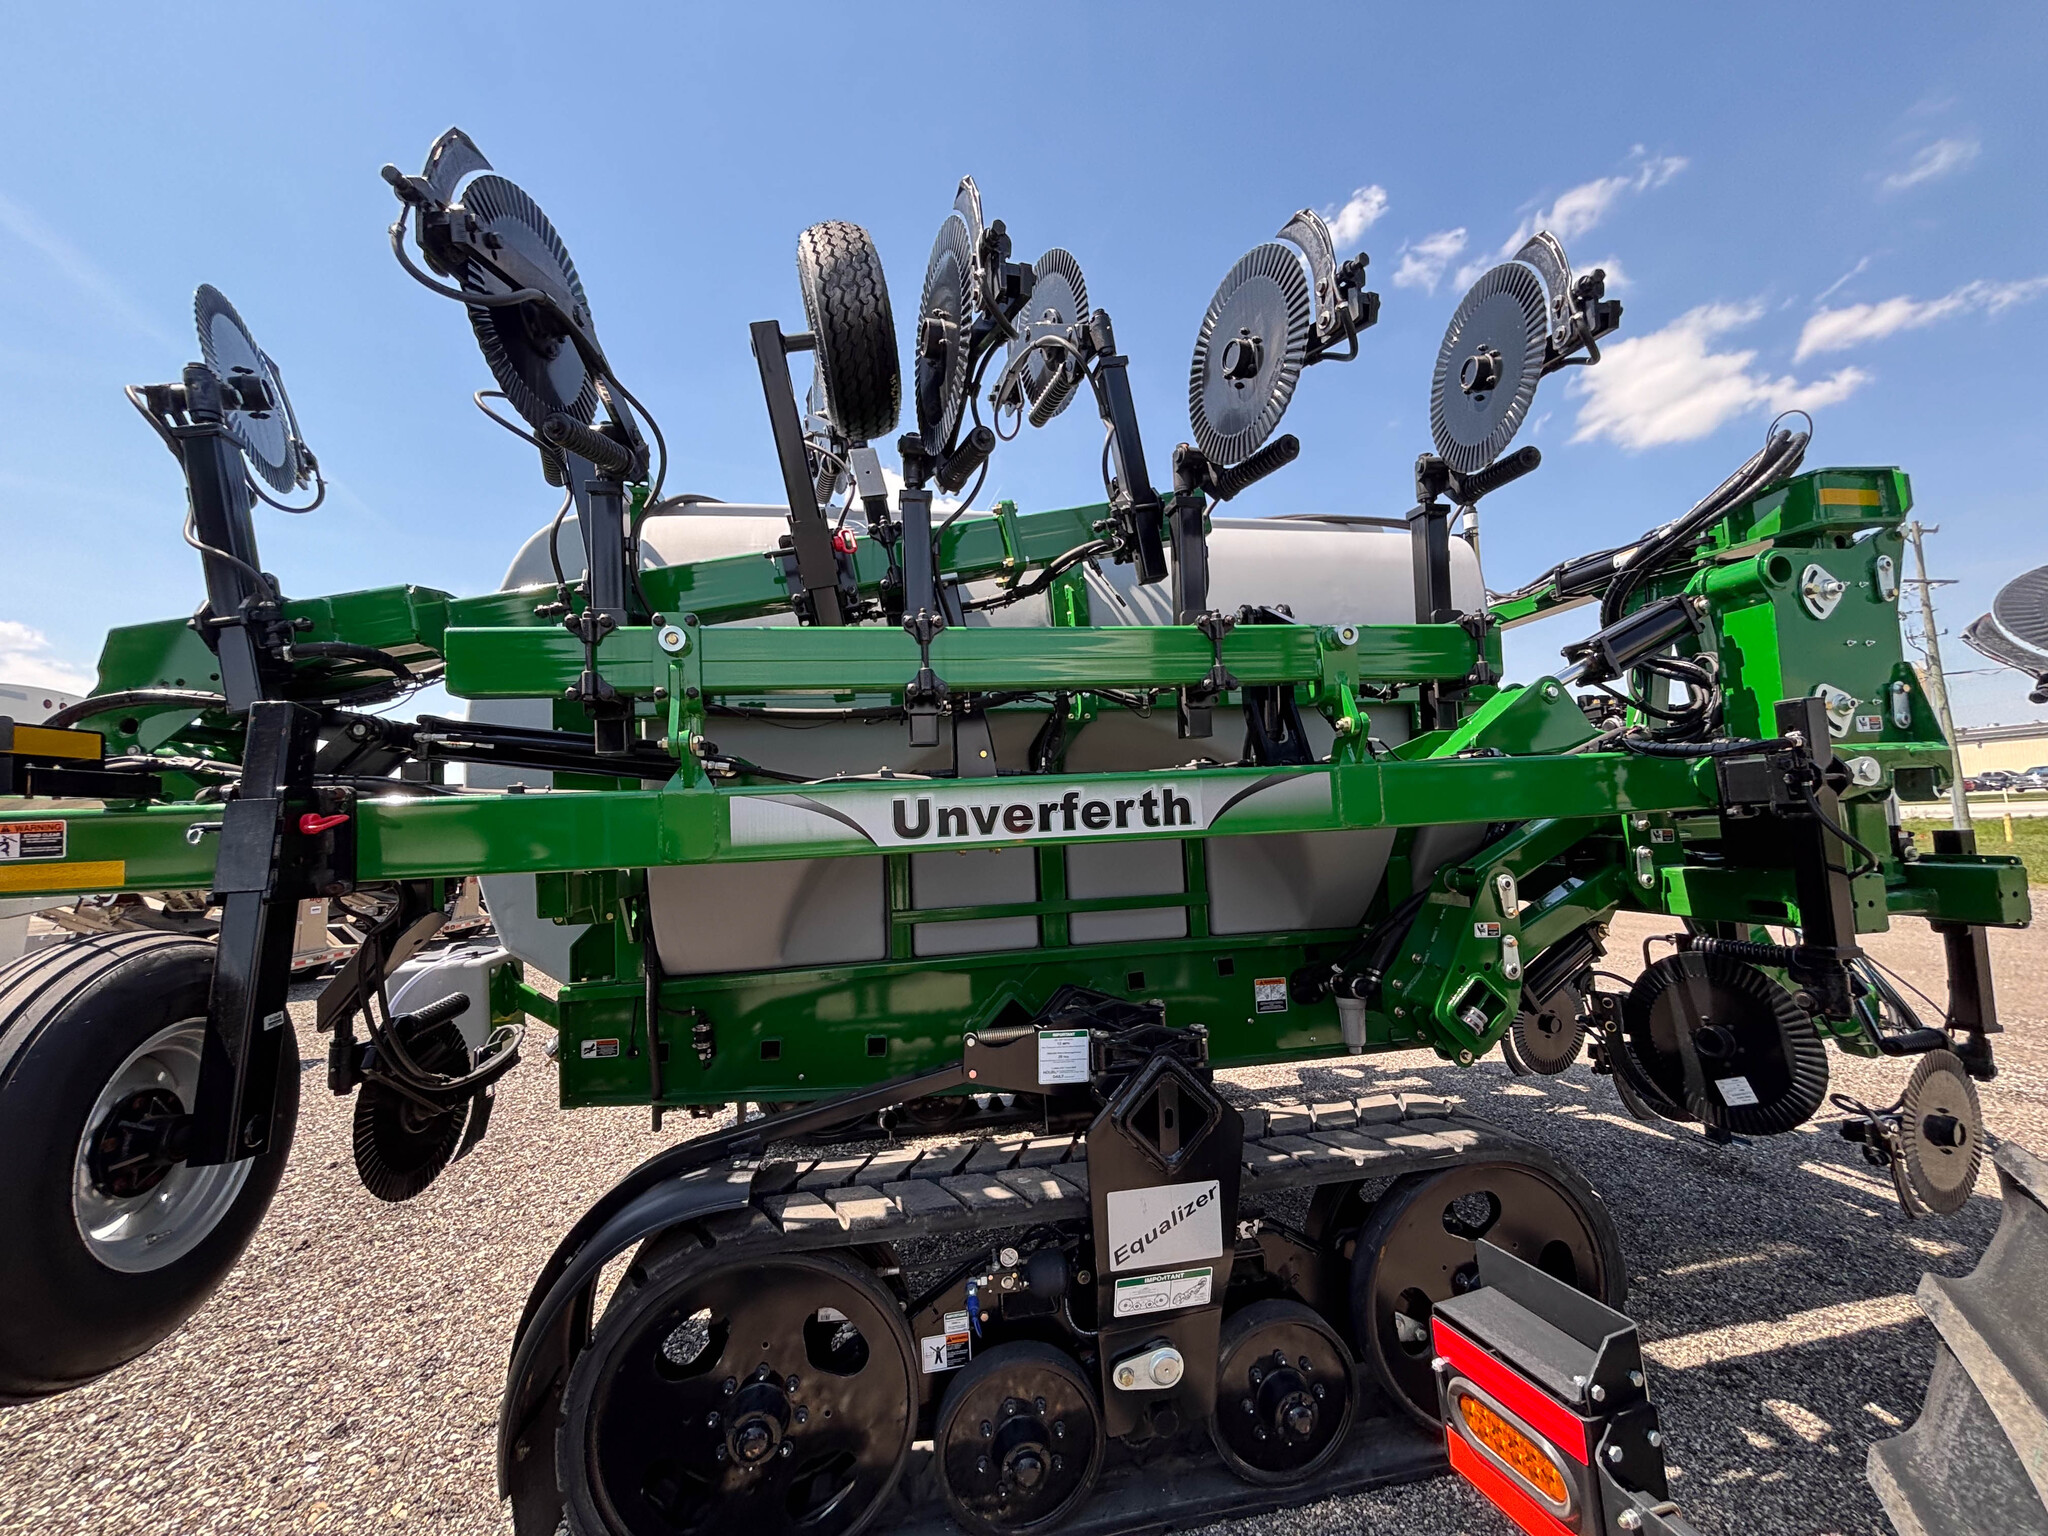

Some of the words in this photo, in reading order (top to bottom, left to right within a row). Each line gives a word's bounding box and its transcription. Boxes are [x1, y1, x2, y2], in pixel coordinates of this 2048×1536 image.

[15, 824, 62, 832] WARNING
[891, 788, 1192, 839] Unverferth
[1113, 1185, 1217, 1266] Equalizer
[1144, 1272, 1185, 1283] IMPORTANT
